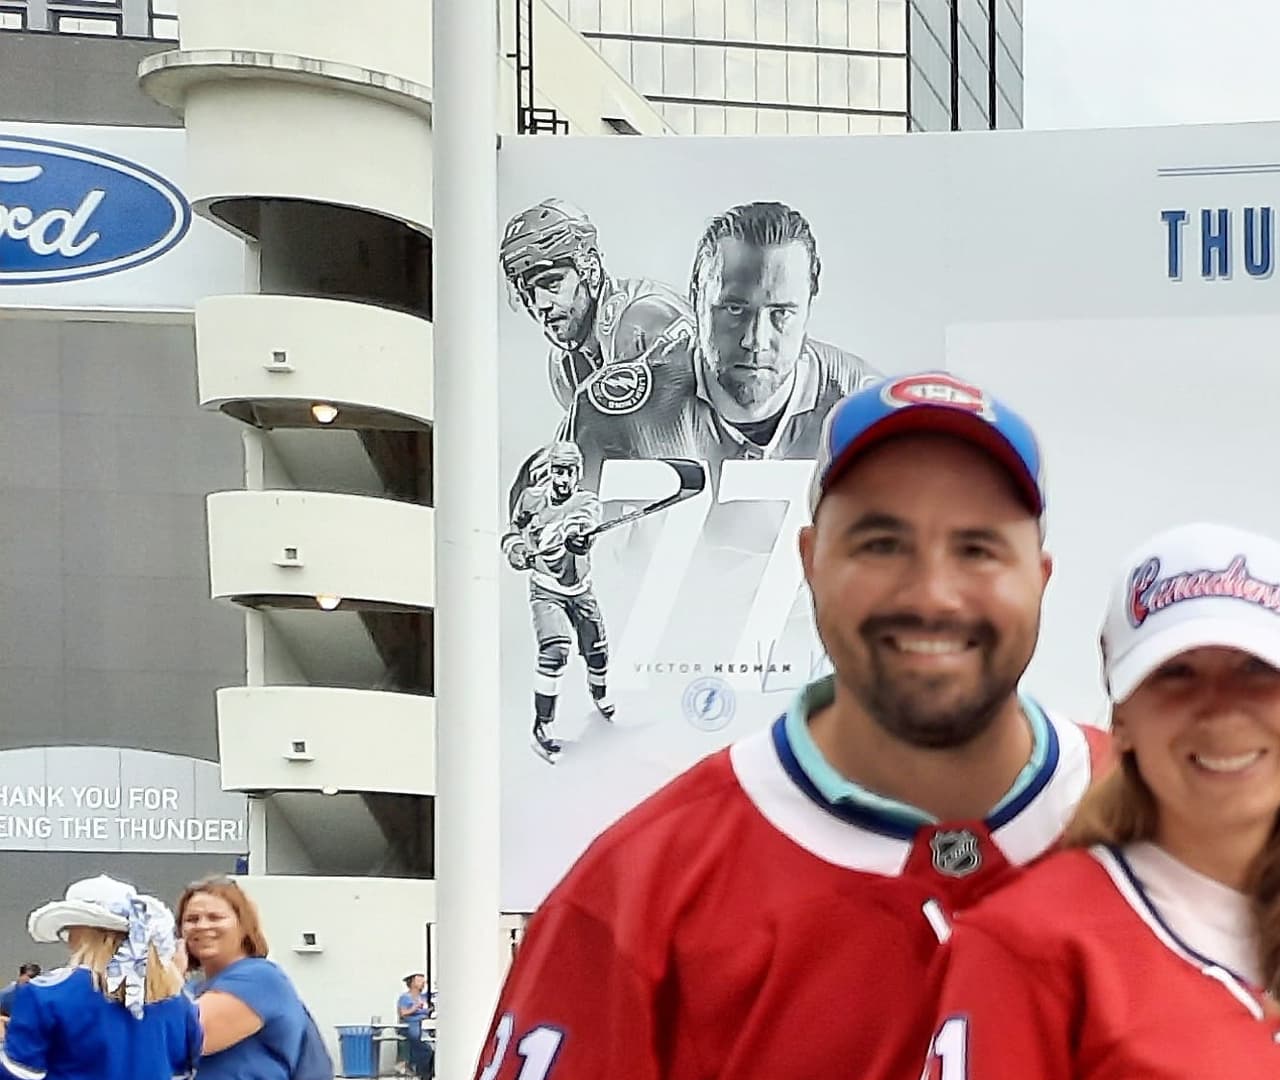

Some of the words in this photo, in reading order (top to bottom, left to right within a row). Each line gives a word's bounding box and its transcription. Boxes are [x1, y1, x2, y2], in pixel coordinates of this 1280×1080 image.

[0, 165, 106, 258] rd
[634, 663, 702, 674] VICTOR
[714, 663, 792, 674] HEDMAN
[72, 786, 120, 810] YOU
[129, 788, 179, 811] FOR
[0, 815, 53, 839] EING
[58, 817, 108, 840] THE
[115, 818, 244, 842] THUNDER!
